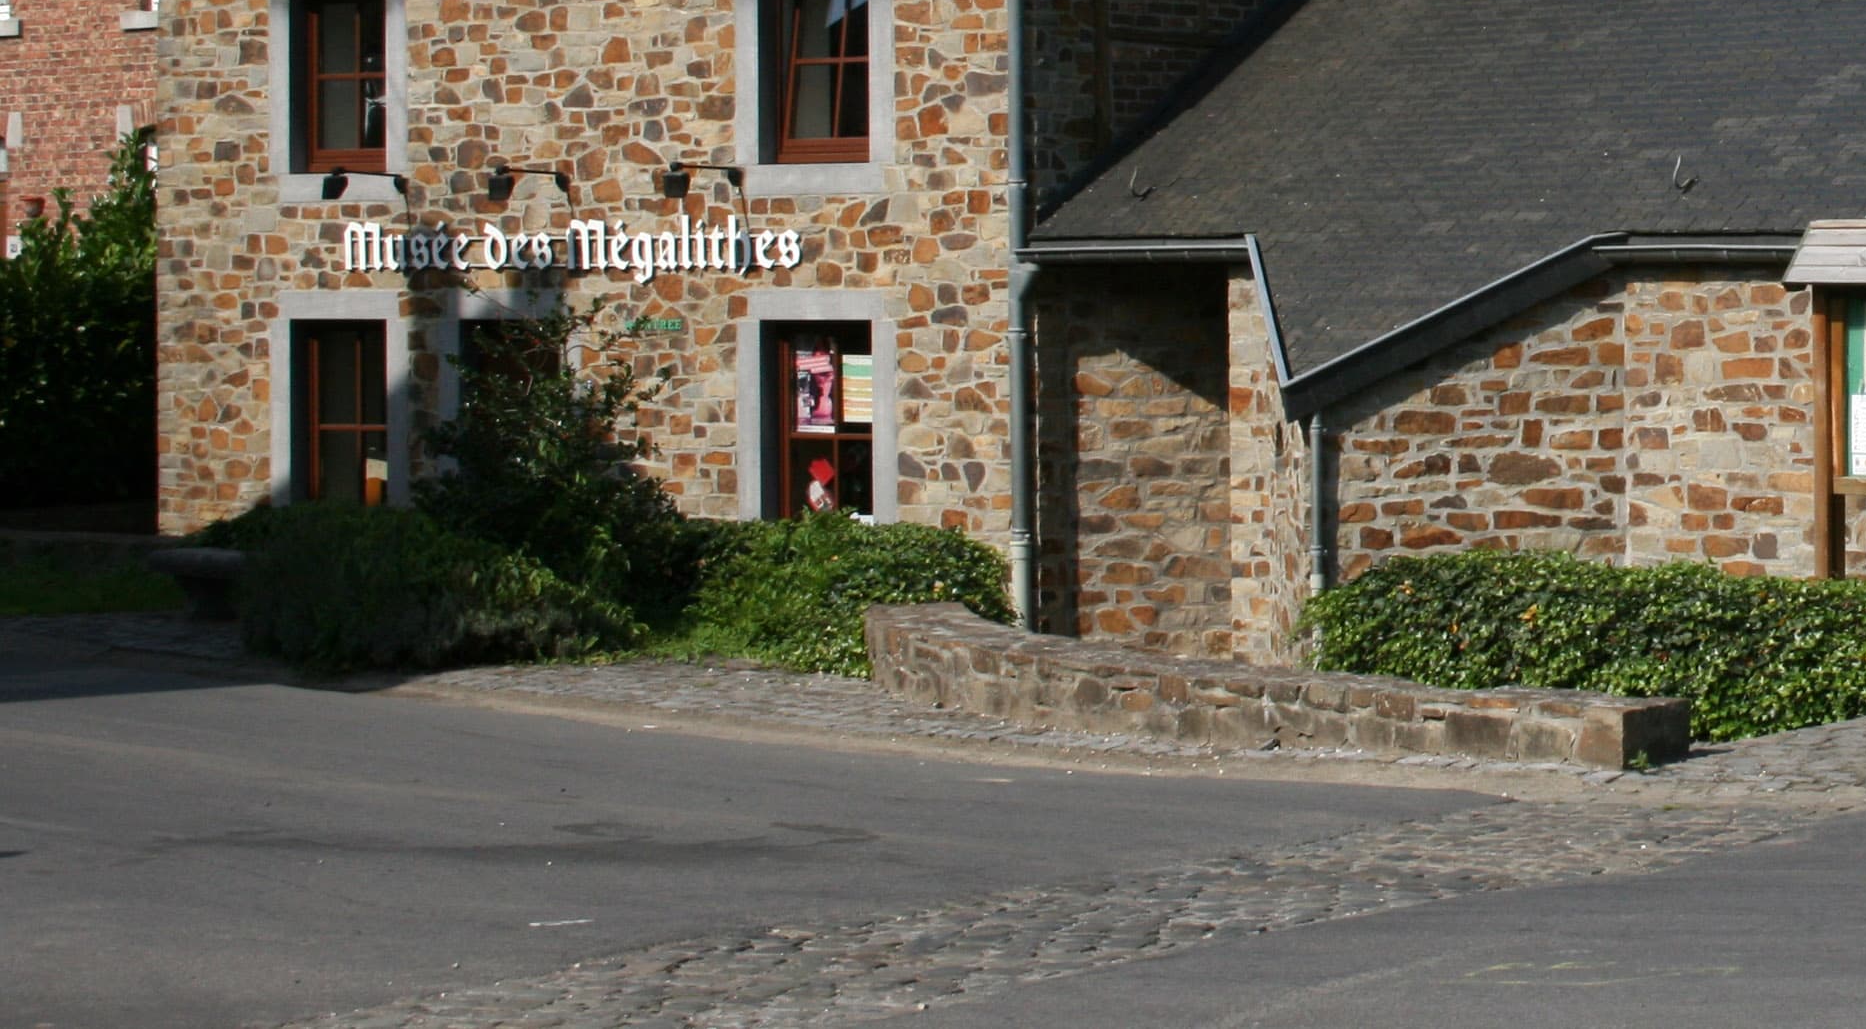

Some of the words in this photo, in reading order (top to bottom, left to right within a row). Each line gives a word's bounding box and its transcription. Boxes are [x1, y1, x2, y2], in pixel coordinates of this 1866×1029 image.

[344, 221, 468, 271] Musée
[483, 222, 553, 271] des
[568, 215, 801, 283] Mégalithes
